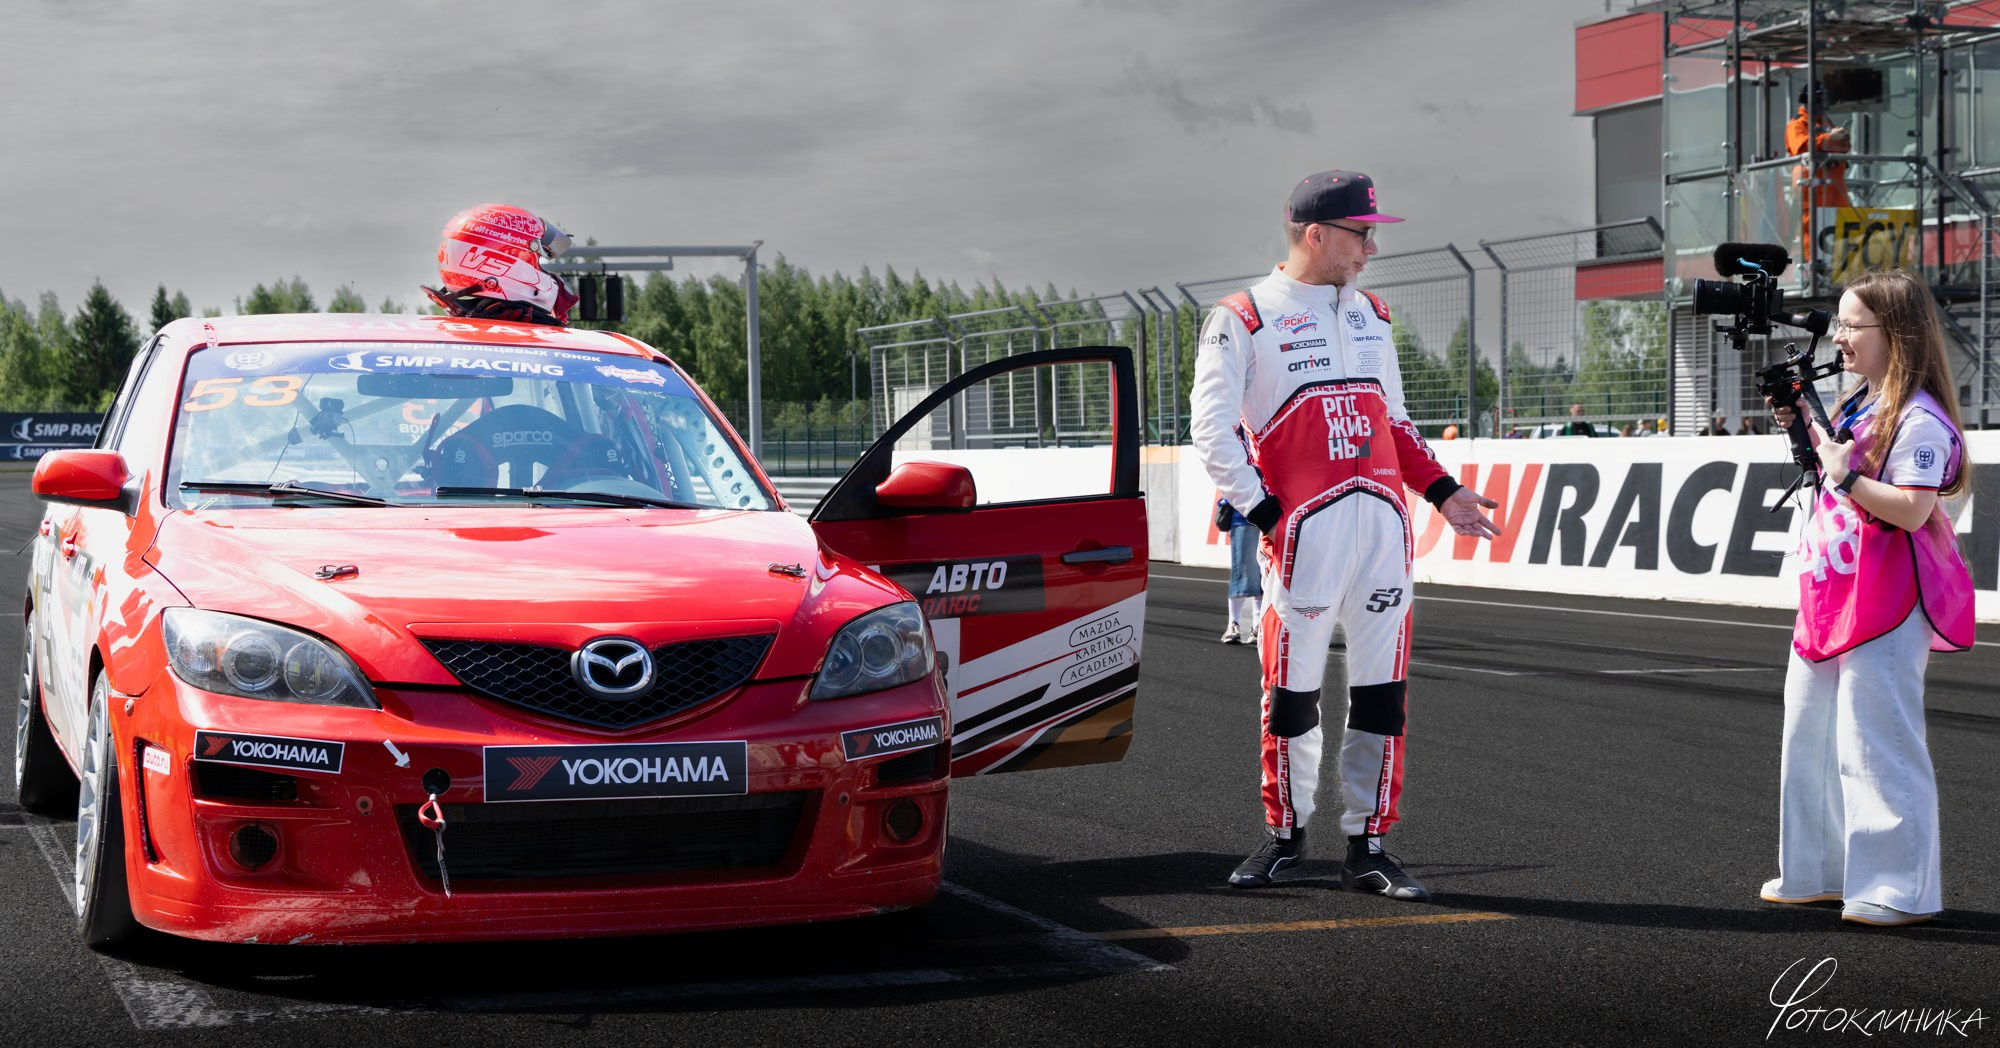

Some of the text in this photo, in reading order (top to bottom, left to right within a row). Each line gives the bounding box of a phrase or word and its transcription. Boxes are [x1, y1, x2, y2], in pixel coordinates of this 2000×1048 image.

[1842, 222, 1912, 269] FCY
[1283, 315, 1310, 327] РСКГ
[450, 344, 549, 357] кольцевых
[553, 351, 602, 362] гонок
[1291, 339, 1327, 349] YOKOHAMA
[376, 355, 565, 377] SMP RACING
[1287, 354, 1331, 373] arriva
[183, 375, 304, 413] 53
[34, 423, 70, 437] SMP
[492, 429, 553, 446] sparco
[1326, 415, 1372, 439] ЖИЗ
[925, 560, 1008, 595] АВТО
[922, 593, 983, 617] ПЛЮС
[1365, 587, 1404, 613] 53
[1079, 617, 1121, 641] MAZDA
[1075, 634, 1124, 662] KARTING
[1069, 651, 1125, 681] ACADEMY
[874, 724, 939, 748] YOKOHAMA
[145, 752, 169, 770] auto.ru
[232, 740, 330, 765] YOKOHAMA
[562, 756, 730, 786] YOKOHAMA
